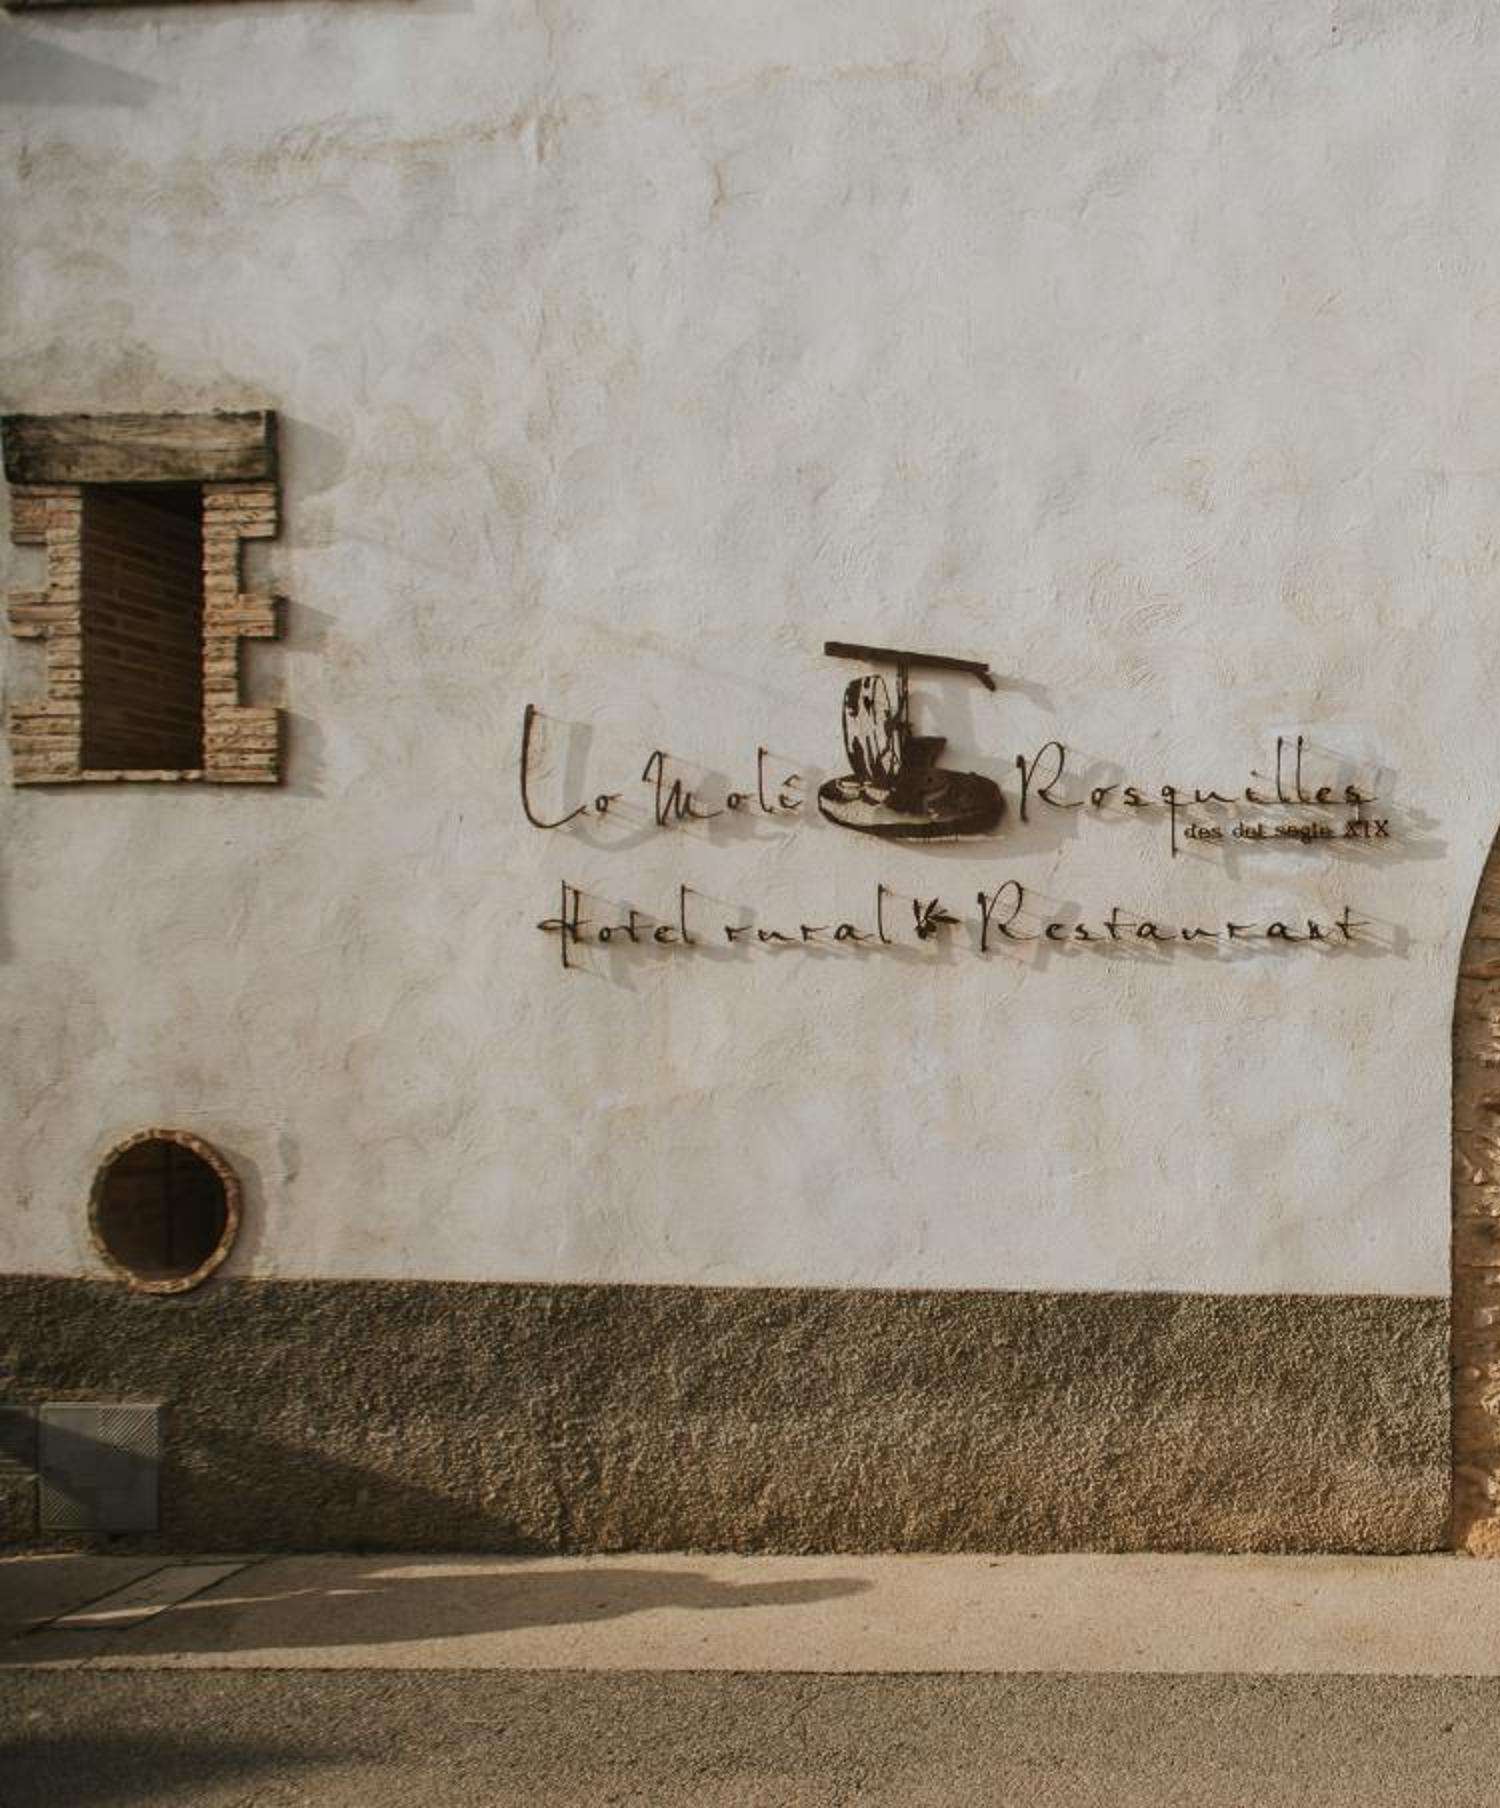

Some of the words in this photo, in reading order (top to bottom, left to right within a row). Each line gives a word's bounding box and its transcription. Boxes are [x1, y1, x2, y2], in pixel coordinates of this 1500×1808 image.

[520, 703, 622, 829] Lo
[1016, 735, 1377, 858] Rosquilles
[1343, 818, 1390, 838] XIX
[537, 880, 696, 968] Hotel
[724, 884, 892, 944] rural
[977, 880, 1373, 952] Restaurant
